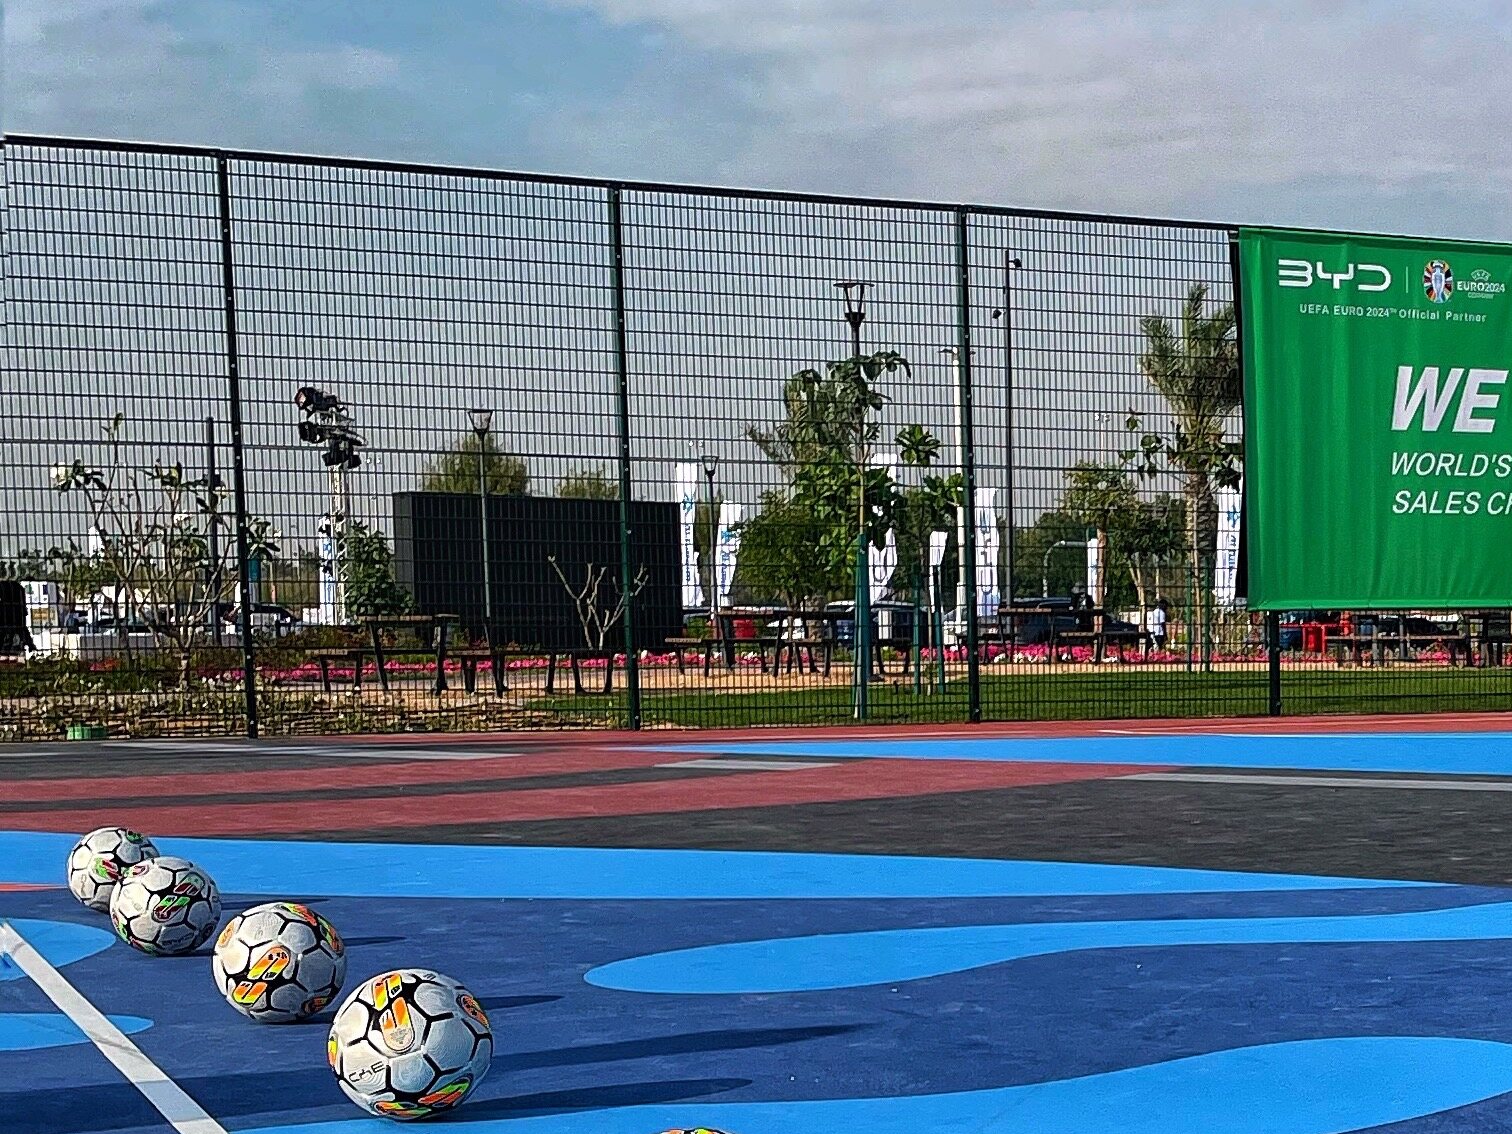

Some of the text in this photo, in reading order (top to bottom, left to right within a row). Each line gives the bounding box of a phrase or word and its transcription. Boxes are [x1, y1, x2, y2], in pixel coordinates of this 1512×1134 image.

[1278, 258, 1392, 292] BYD
[1300, 303, 1330, 316] UEFA
[1334, 305, 1364, 317] EURO
[1399, 308, 1440, 320] Official
[1446, 312, 1487, 323] Partner
[1390, 366, 1509, 434] WE
[1392, 451, 1512, 479] WORLD'S
[1392, 489, 1481, 515] SALES
